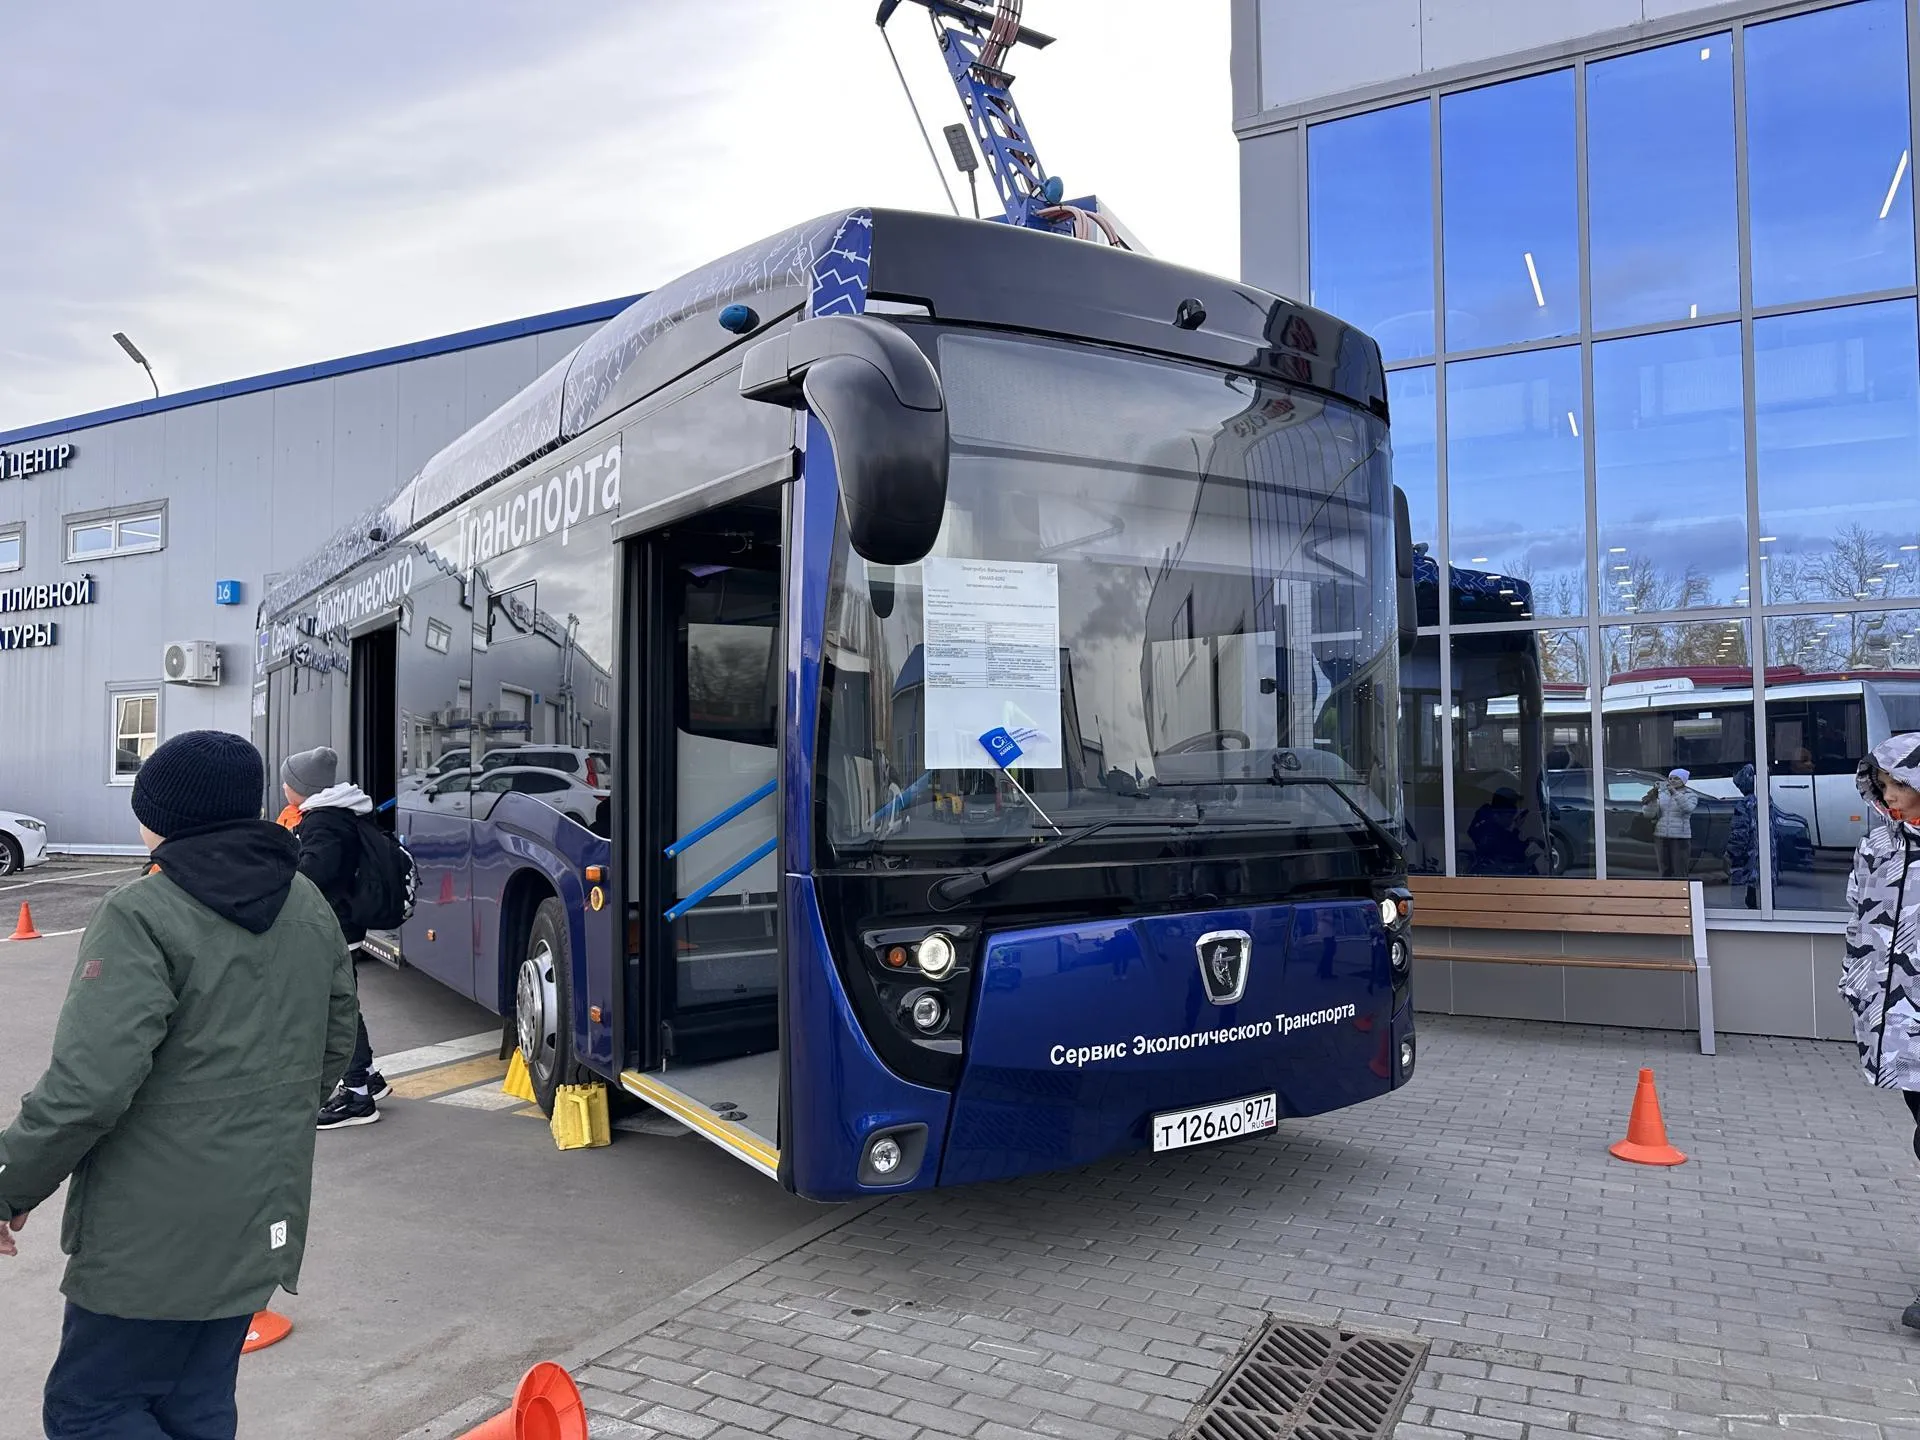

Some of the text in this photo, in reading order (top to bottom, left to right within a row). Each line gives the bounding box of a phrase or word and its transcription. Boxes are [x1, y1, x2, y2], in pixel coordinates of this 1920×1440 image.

[10, 444, 70, 479] ЦЕНТР
[314, 554, 413, 637] Экологического
[456, 444, 622, 597] Транспорта
[0, 573, 89, 613] ПЛИВНОЙ
[217, 584, 230, 600] 16
[0, 622, 52, 650] ТУРЫ
[1050, 1003, 1356, 1068] Сервис Экологического Транспорта
[1245, 1097, 1271, 1122] 977
[1251, 1121, 1265, 1130] RUS
